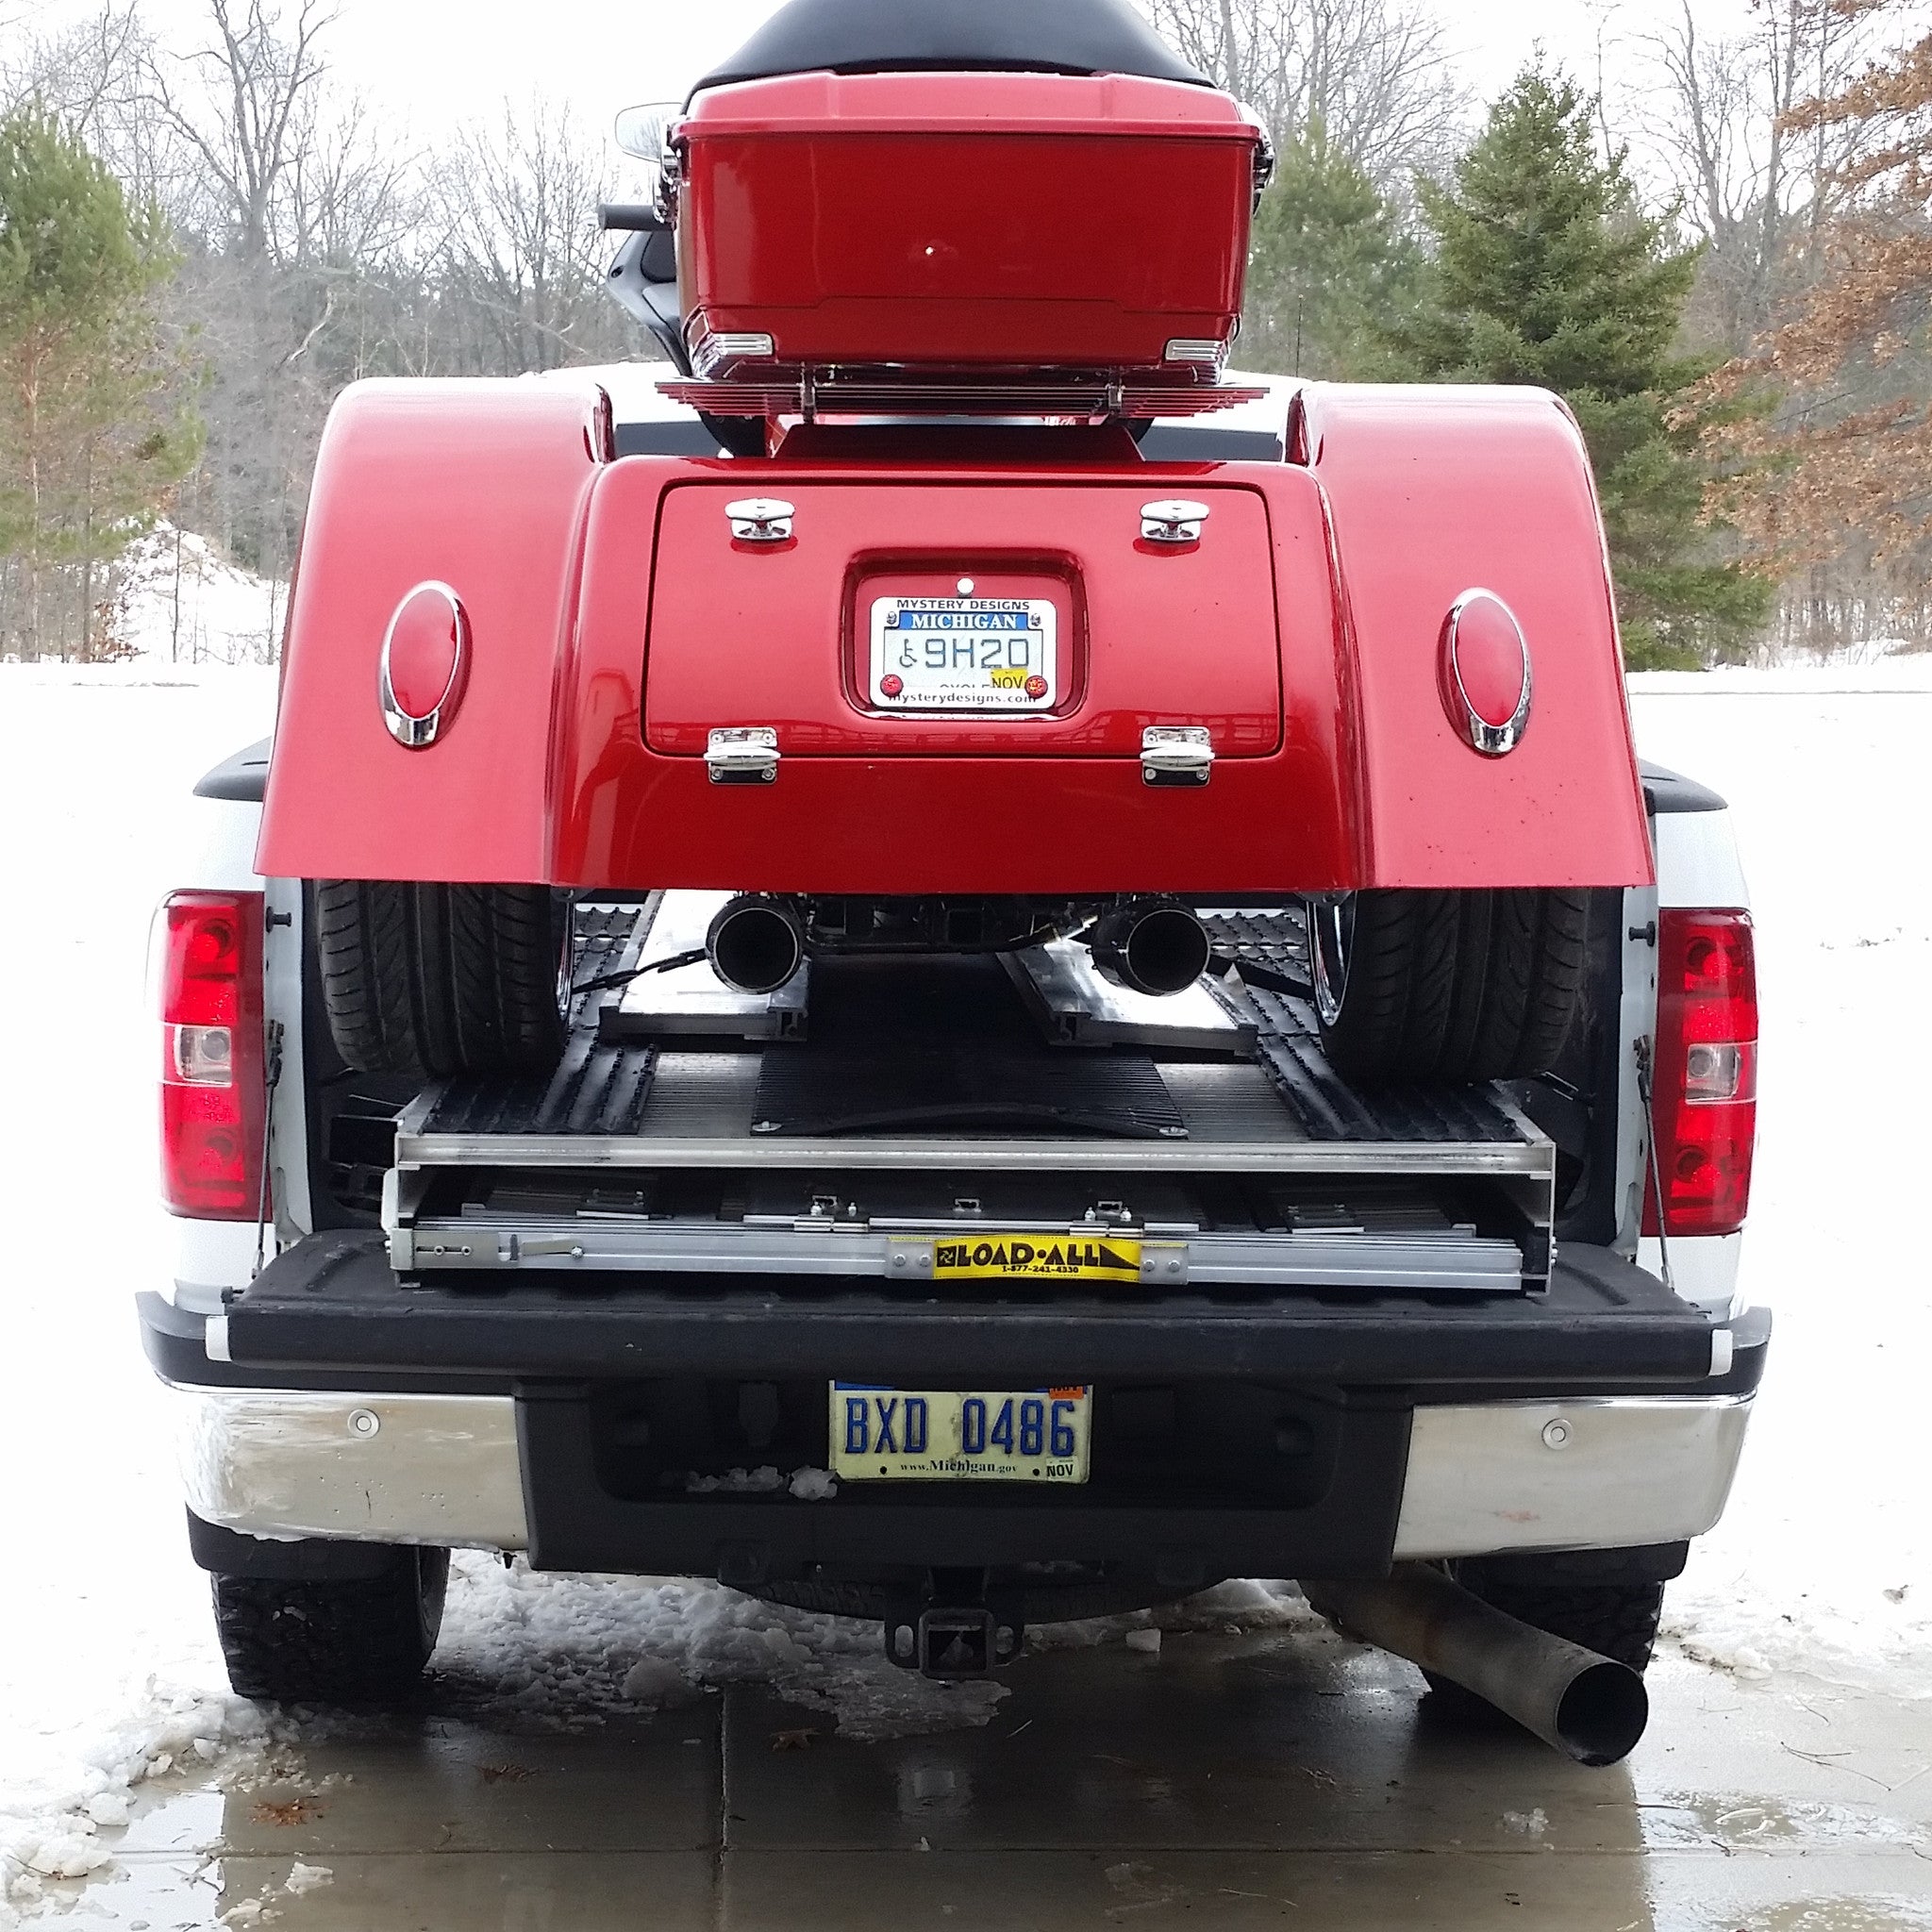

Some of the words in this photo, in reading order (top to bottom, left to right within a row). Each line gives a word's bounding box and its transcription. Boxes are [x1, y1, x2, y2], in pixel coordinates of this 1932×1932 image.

[896, 599, 964, 609] MYSTERY
[970, 600, 1030, 610] DESIGNS
[910, 613, 1018, 629] MICHIGAN
[991, 675, 1024, 690] NOV
[845, 1397, 928, 1454] BXD
[961, 1398, 1074, 1457] 0486
[900, 1459, 1018, 1474] www.Michigan.gov
[1046, 1464, 1074, 1477] NOV
